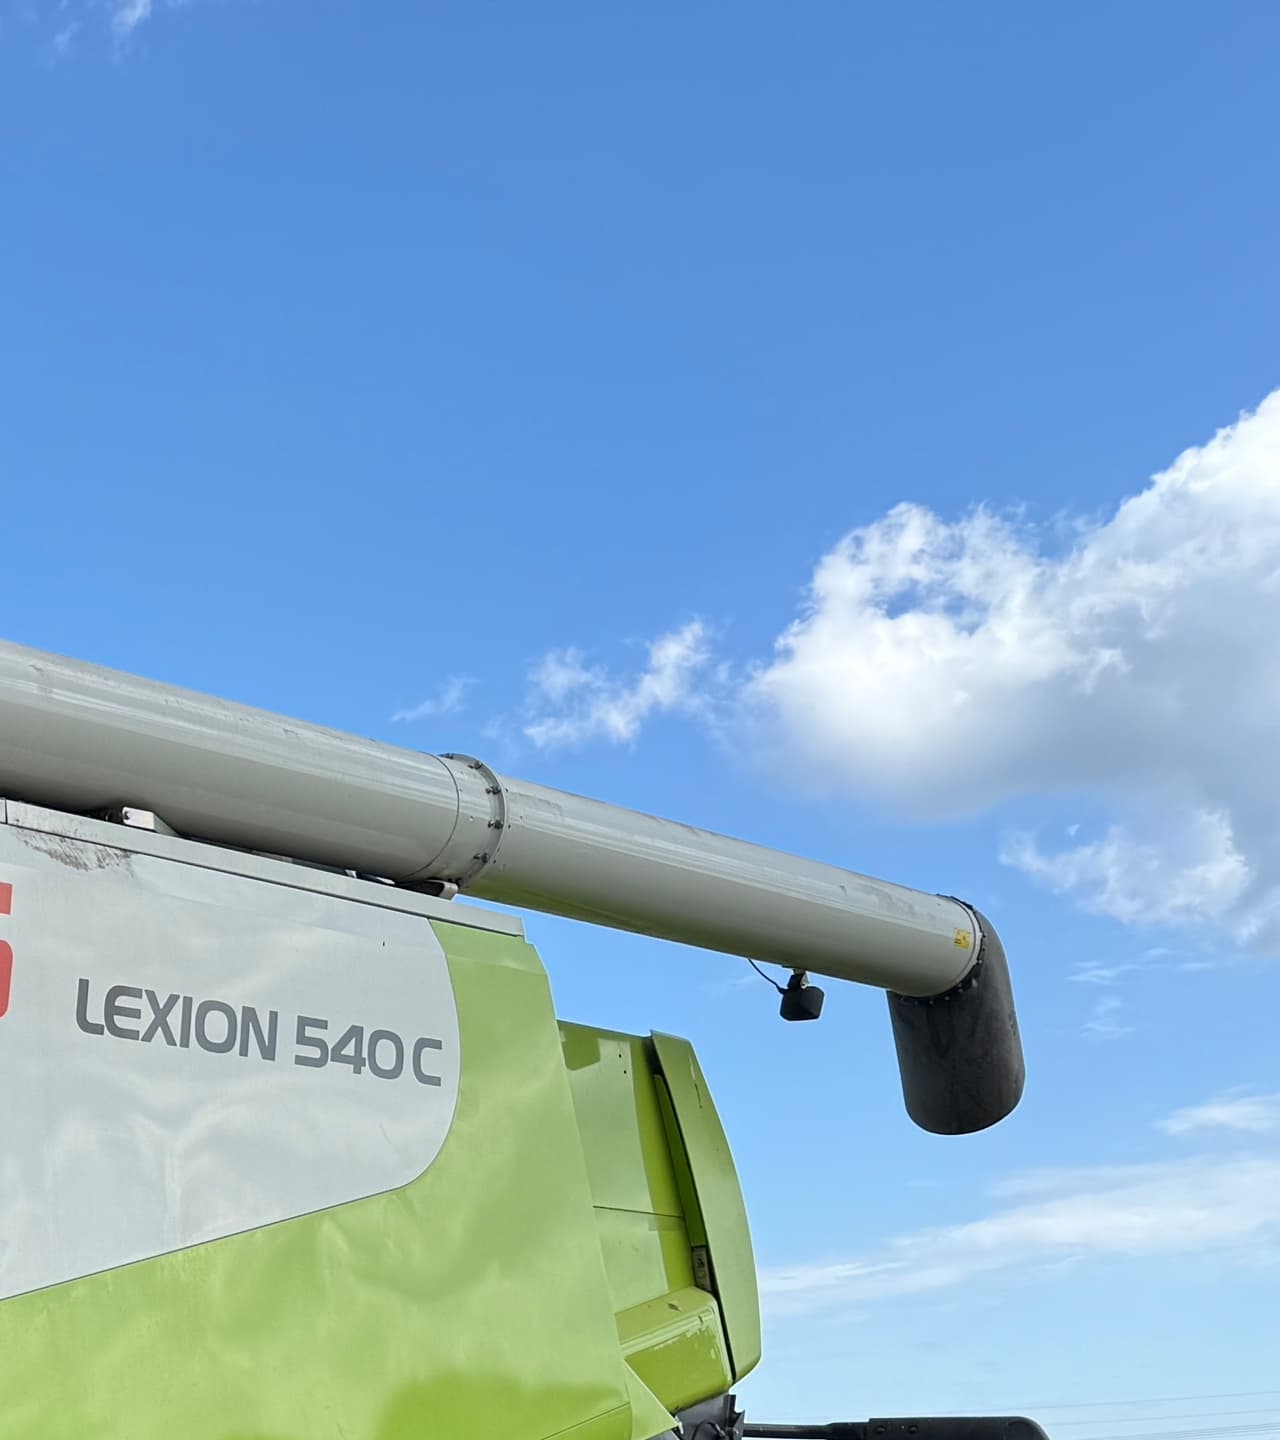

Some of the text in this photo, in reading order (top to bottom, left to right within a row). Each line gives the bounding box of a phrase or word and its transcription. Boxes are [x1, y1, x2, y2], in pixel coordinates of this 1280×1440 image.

[75, 977, 443, 1088] LEXION 540 C
